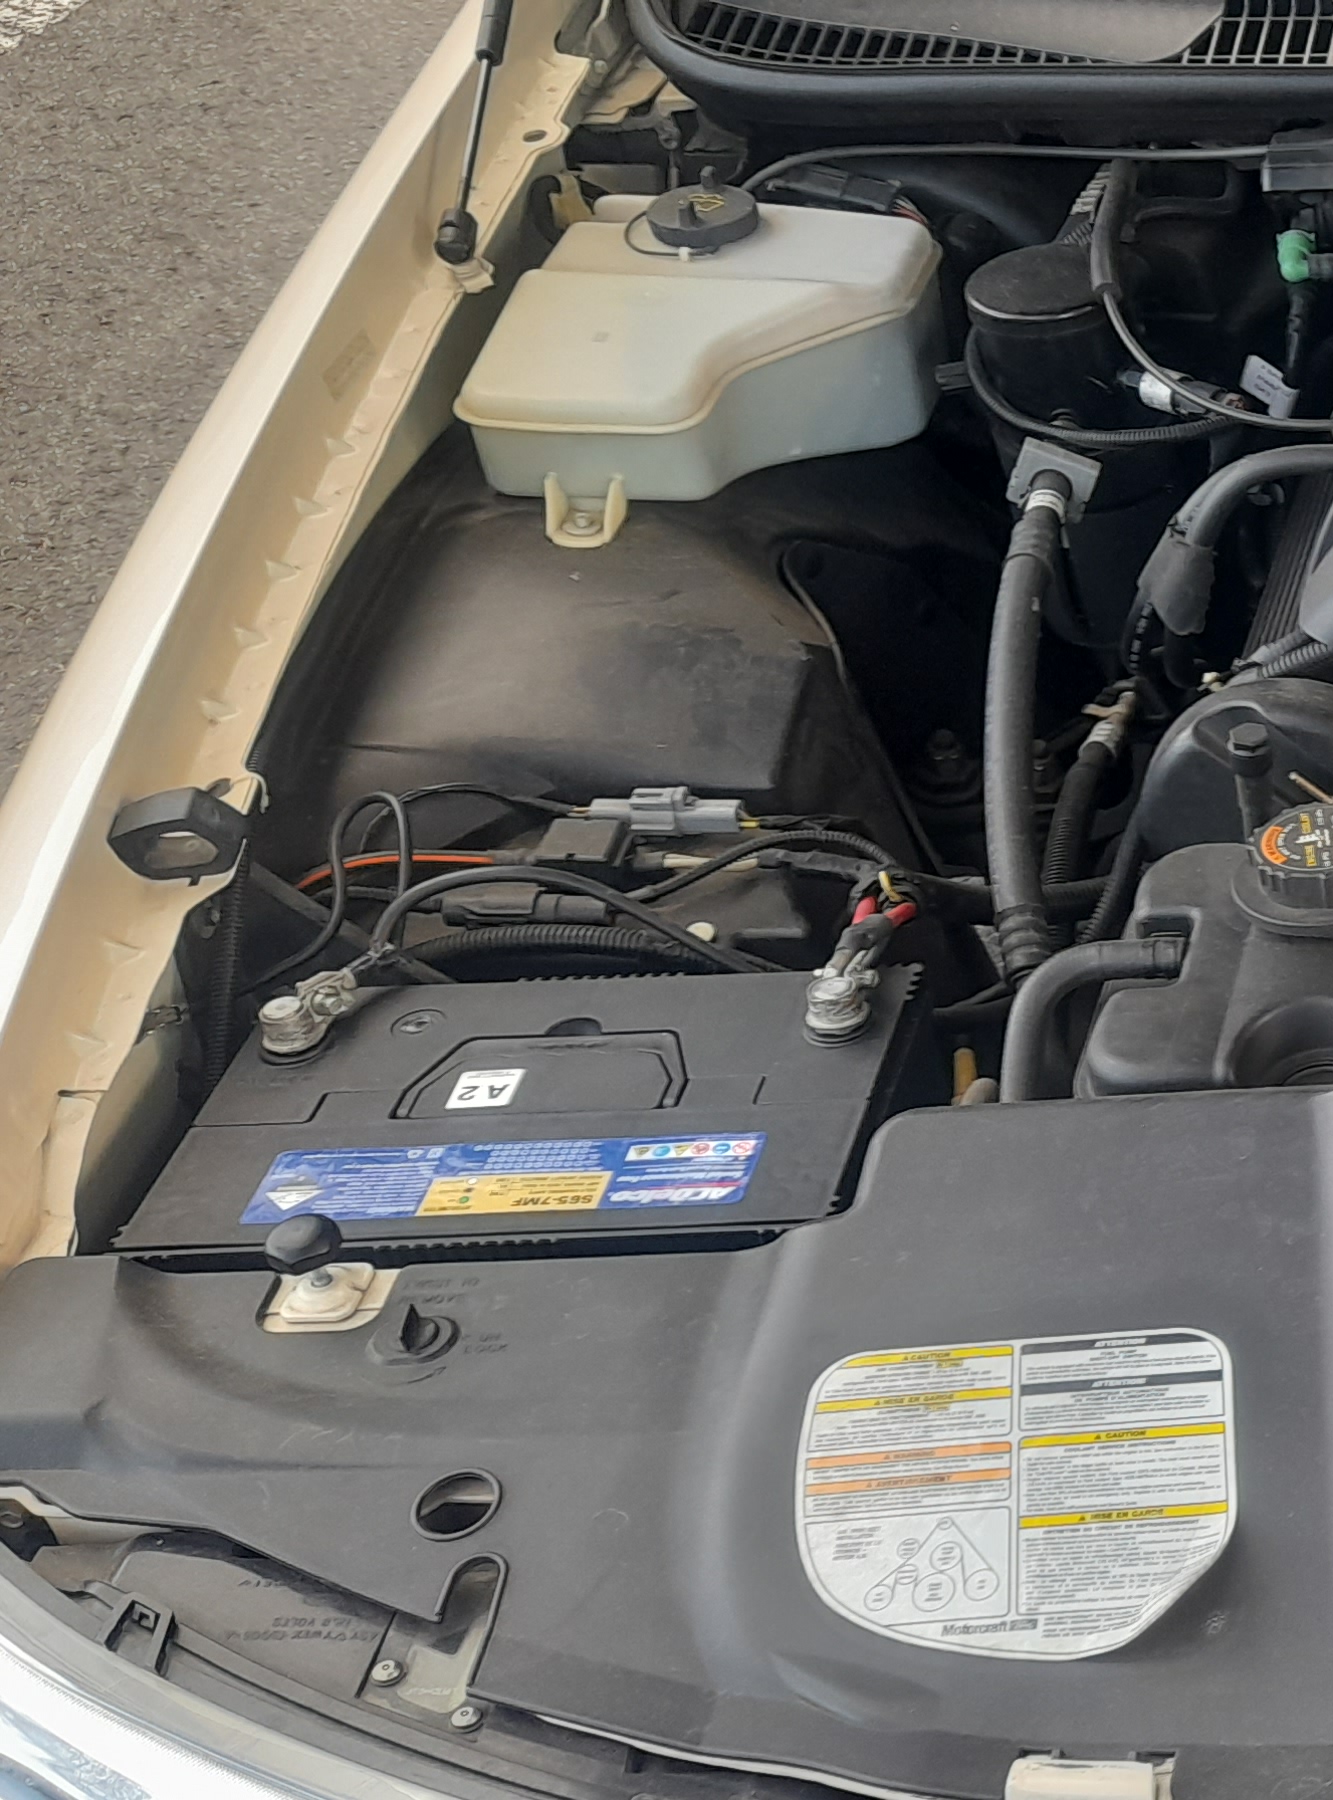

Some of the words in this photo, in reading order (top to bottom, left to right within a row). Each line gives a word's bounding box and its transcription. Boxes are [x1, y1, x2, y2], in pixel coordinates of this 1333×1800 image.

[608, 1187, 737, 1204] ACDelco
[910, 1352, 951, 1361] CAUTION
[1105, 1430, 1147, 1440] CAUTION
[940, 1620, 1008, 1637] Motorcraft
